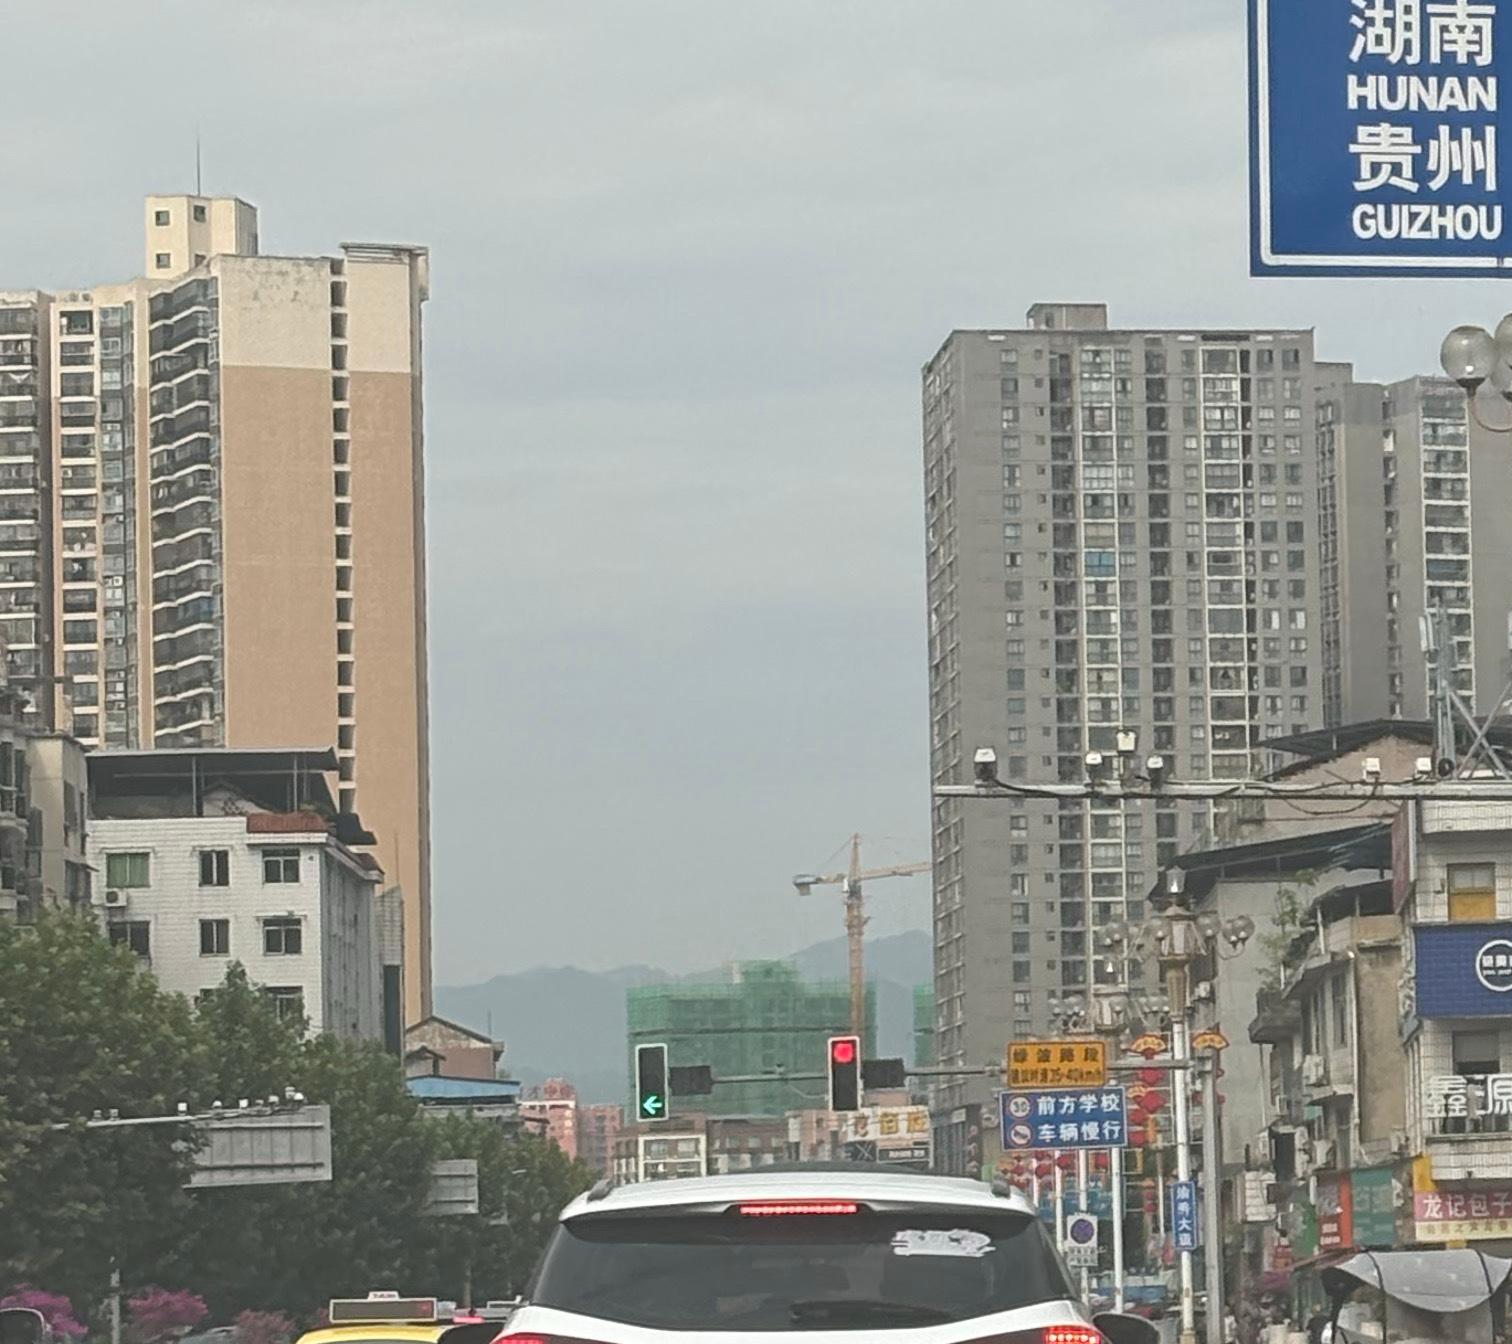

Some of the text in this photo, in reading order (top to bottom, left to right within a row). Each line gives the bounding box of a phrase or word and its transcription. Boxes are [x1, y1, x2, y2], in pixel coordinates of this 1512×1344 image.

[1347, 74, 1497, 112] HUNAN
[1348, 122, 1498, 194] 贵州
[1352, 203, 1502, 240] GUIZHOU
[1037, 1093, 1121, 1116] 前方学校
[1037, 1120, 1122, 1143] 车辆慢行
[1422, 1191, 1512, 1219] 龙记包子
